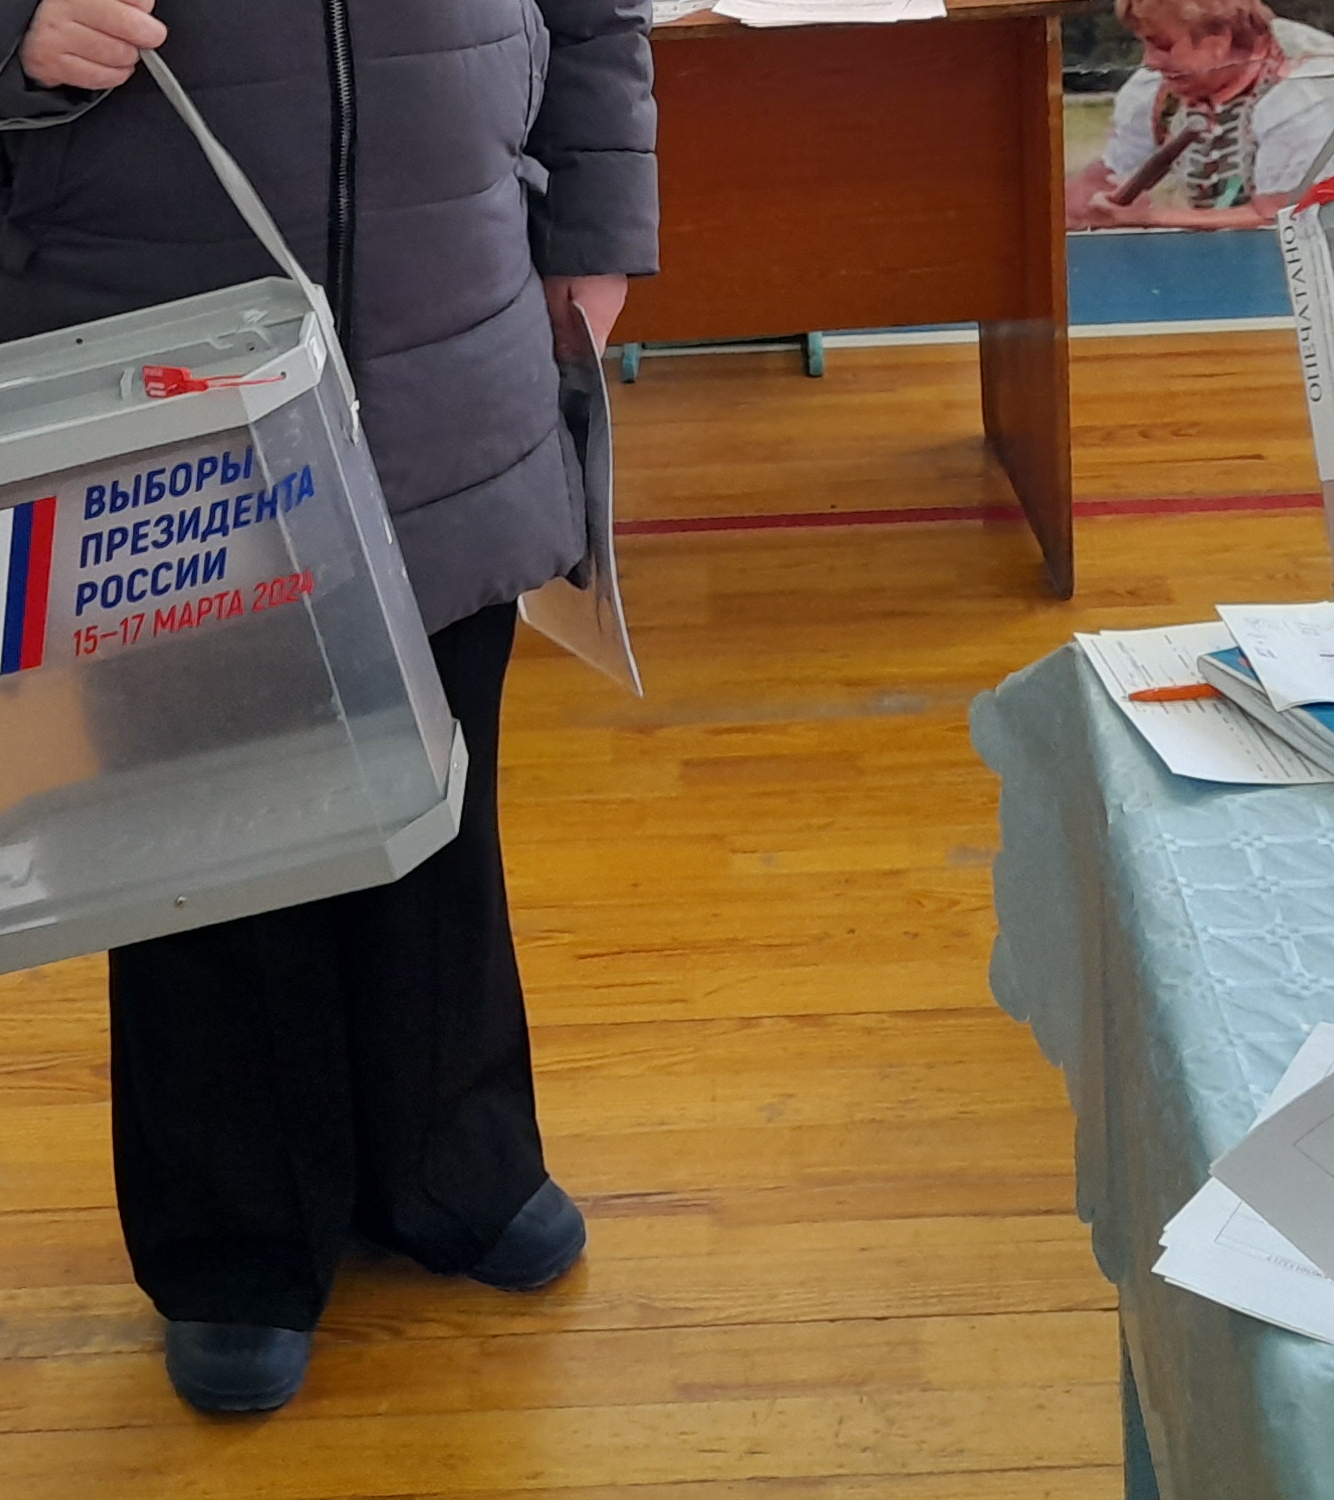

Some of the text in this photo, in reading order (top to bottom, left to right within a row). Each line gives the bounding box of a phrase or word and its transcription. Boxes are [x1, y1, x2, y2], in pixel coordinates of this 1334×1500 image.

[1282, 224, 1323, 403] ОПЕЧАТАНО
[79, 464, 315, 569] ПРЕЗИДЕНТА
[84, 445, 255, 521] ВЫБОРЫ
[74, 546, 228, 617] РОССИИ
[153, 588, 244, 638] МАРТА
[251, 568, 315, 613] 2024
